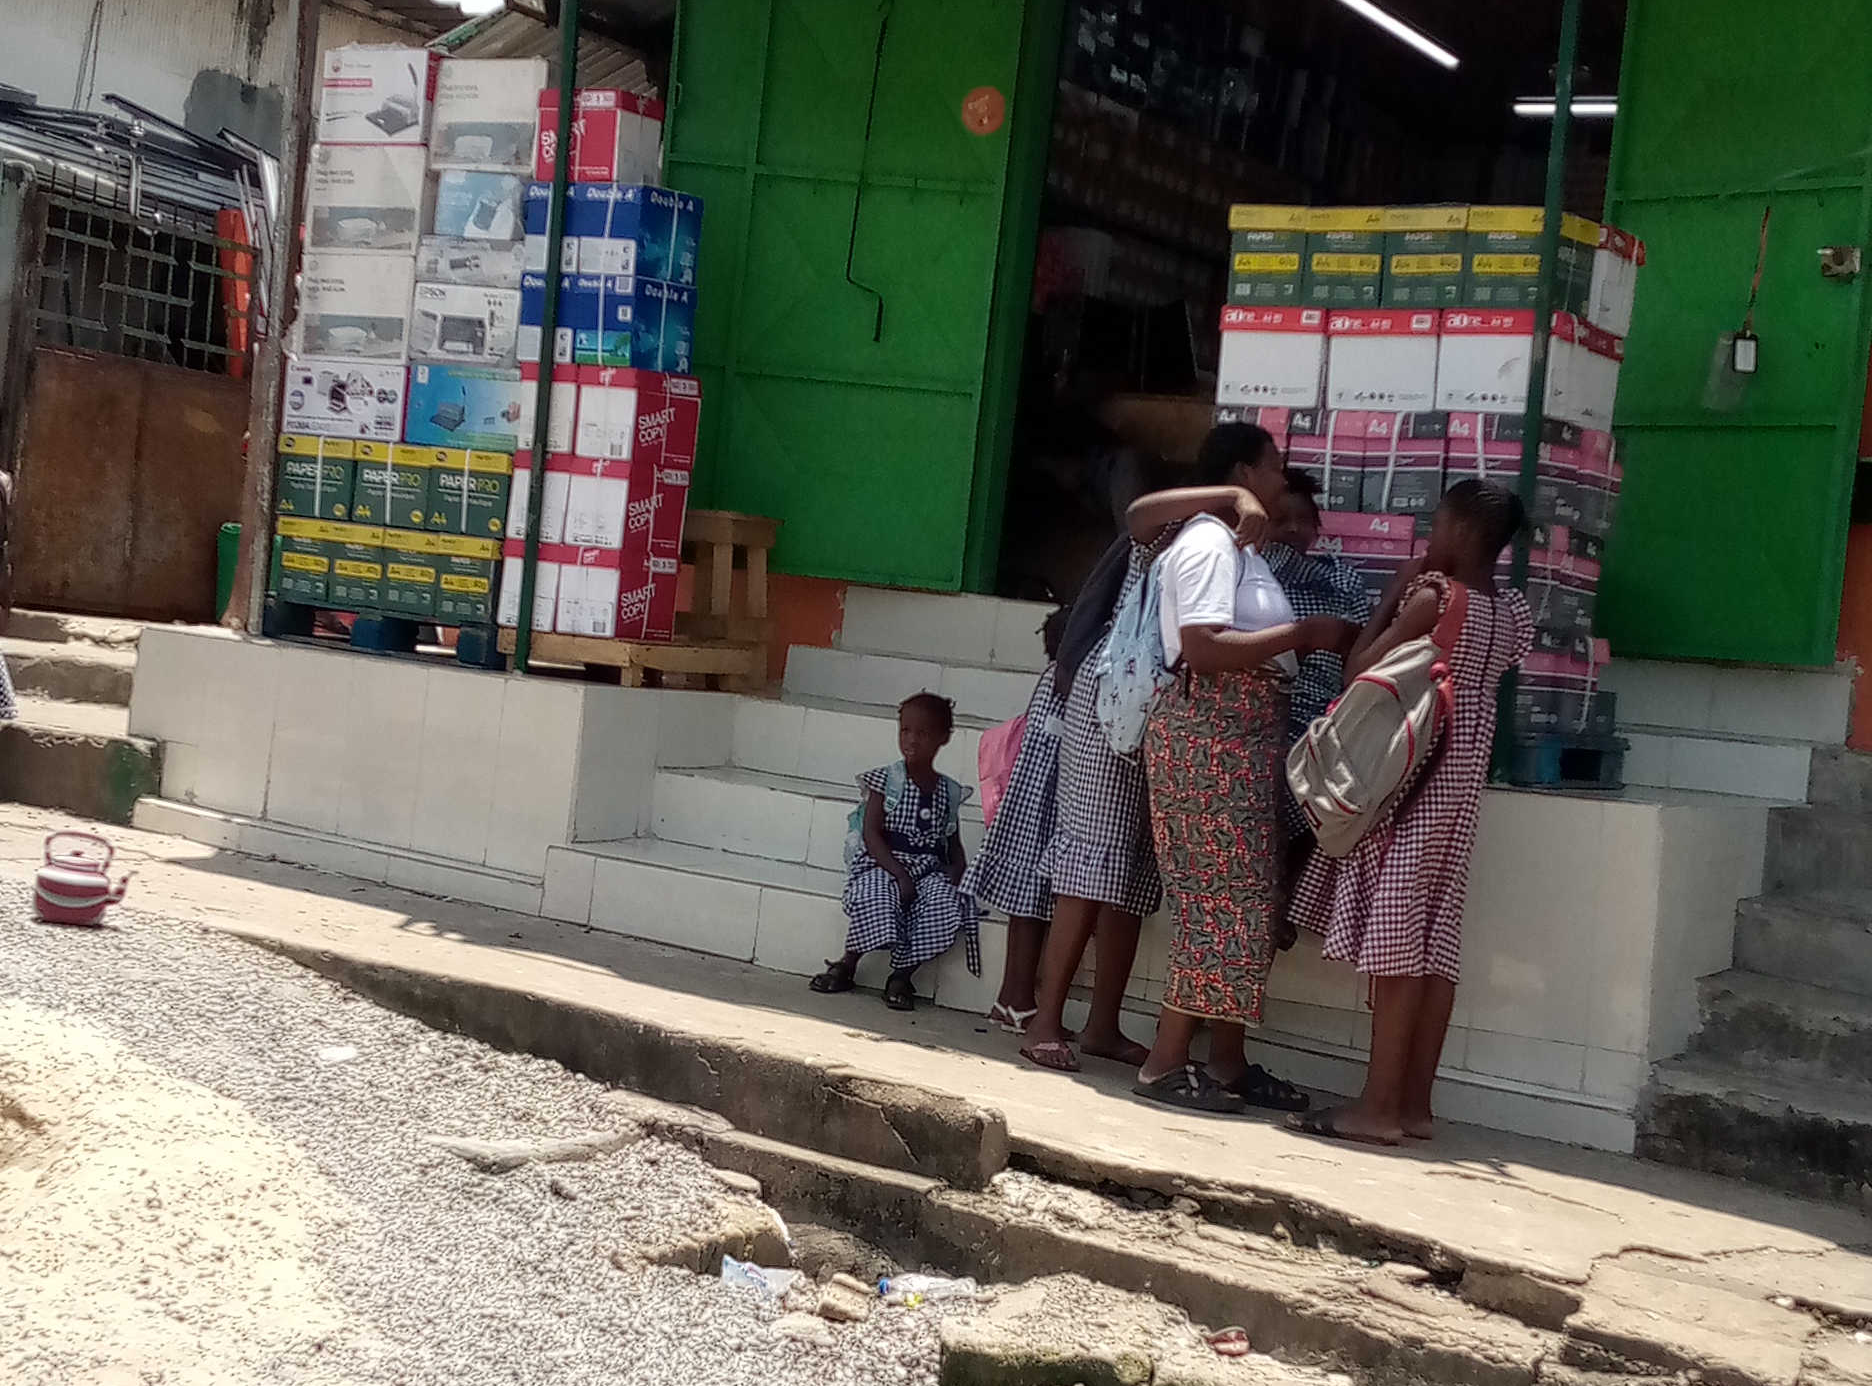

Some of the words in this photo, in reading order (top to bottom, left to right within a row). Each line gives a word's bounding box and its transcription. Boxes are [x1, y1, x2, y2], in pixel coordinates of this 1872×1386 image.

[625, 188, 636, 200] A
[686, 200, 694, 212] A
[681, 290, 689, 304] A
[637, 407, 677, 429] SMART
[1292, 414, 1312, 428] A4
[1368, 419, 1388, 435] A4
[1450, 419, 1470, 435] A4
[638, 427, 664, 444] COPY
[628, 493, 664, 517] SMART
[1369, 517, 1390, 533] A4
[1315, 536, 1344, 553] A4
[620, 583, 656, 607] SMART
[621, 602, 646, 620] COPY
